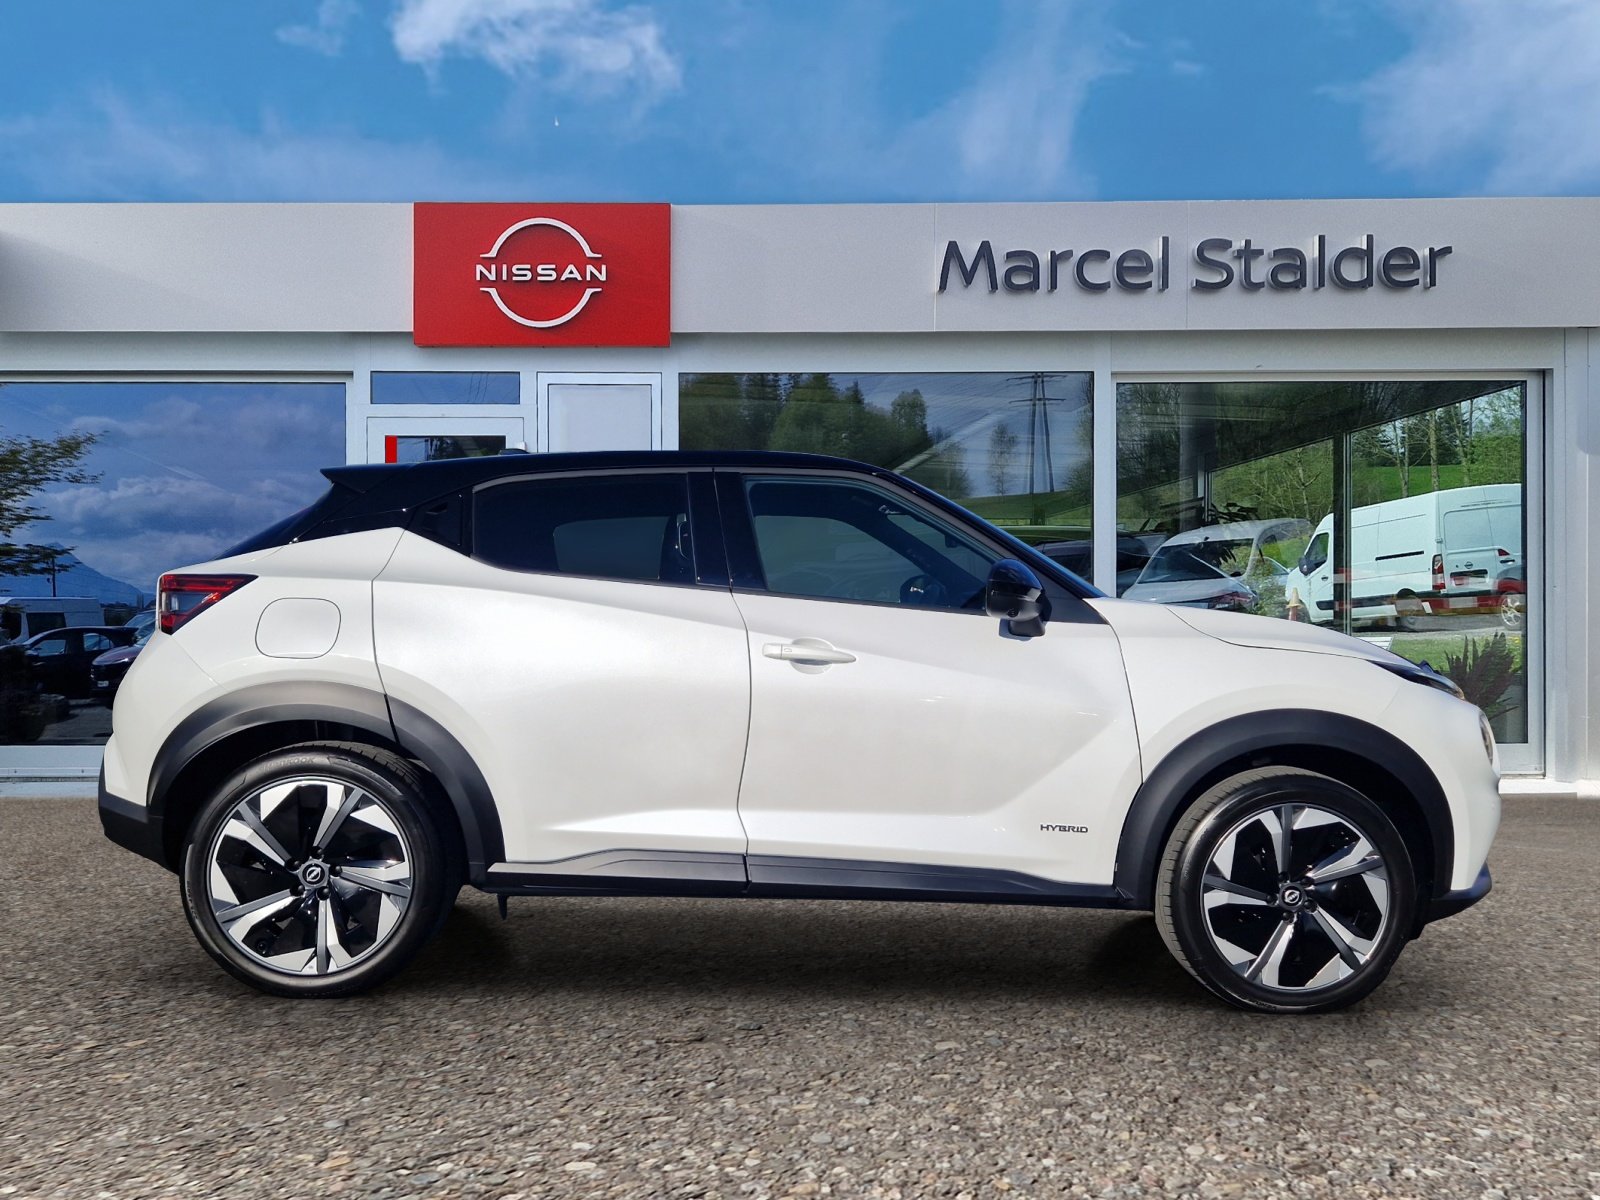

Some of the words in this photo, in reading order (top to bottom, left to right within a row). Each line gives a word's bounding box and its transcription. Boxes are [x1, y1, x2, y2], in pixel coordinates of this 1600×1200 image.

[937, 235, 1170, 293] Marcel
[1191, 234, 1453, 290] Stalder
[475, 264, 607, 282] NISSAN
[1040, 824, 1089, 833] HYBRID
